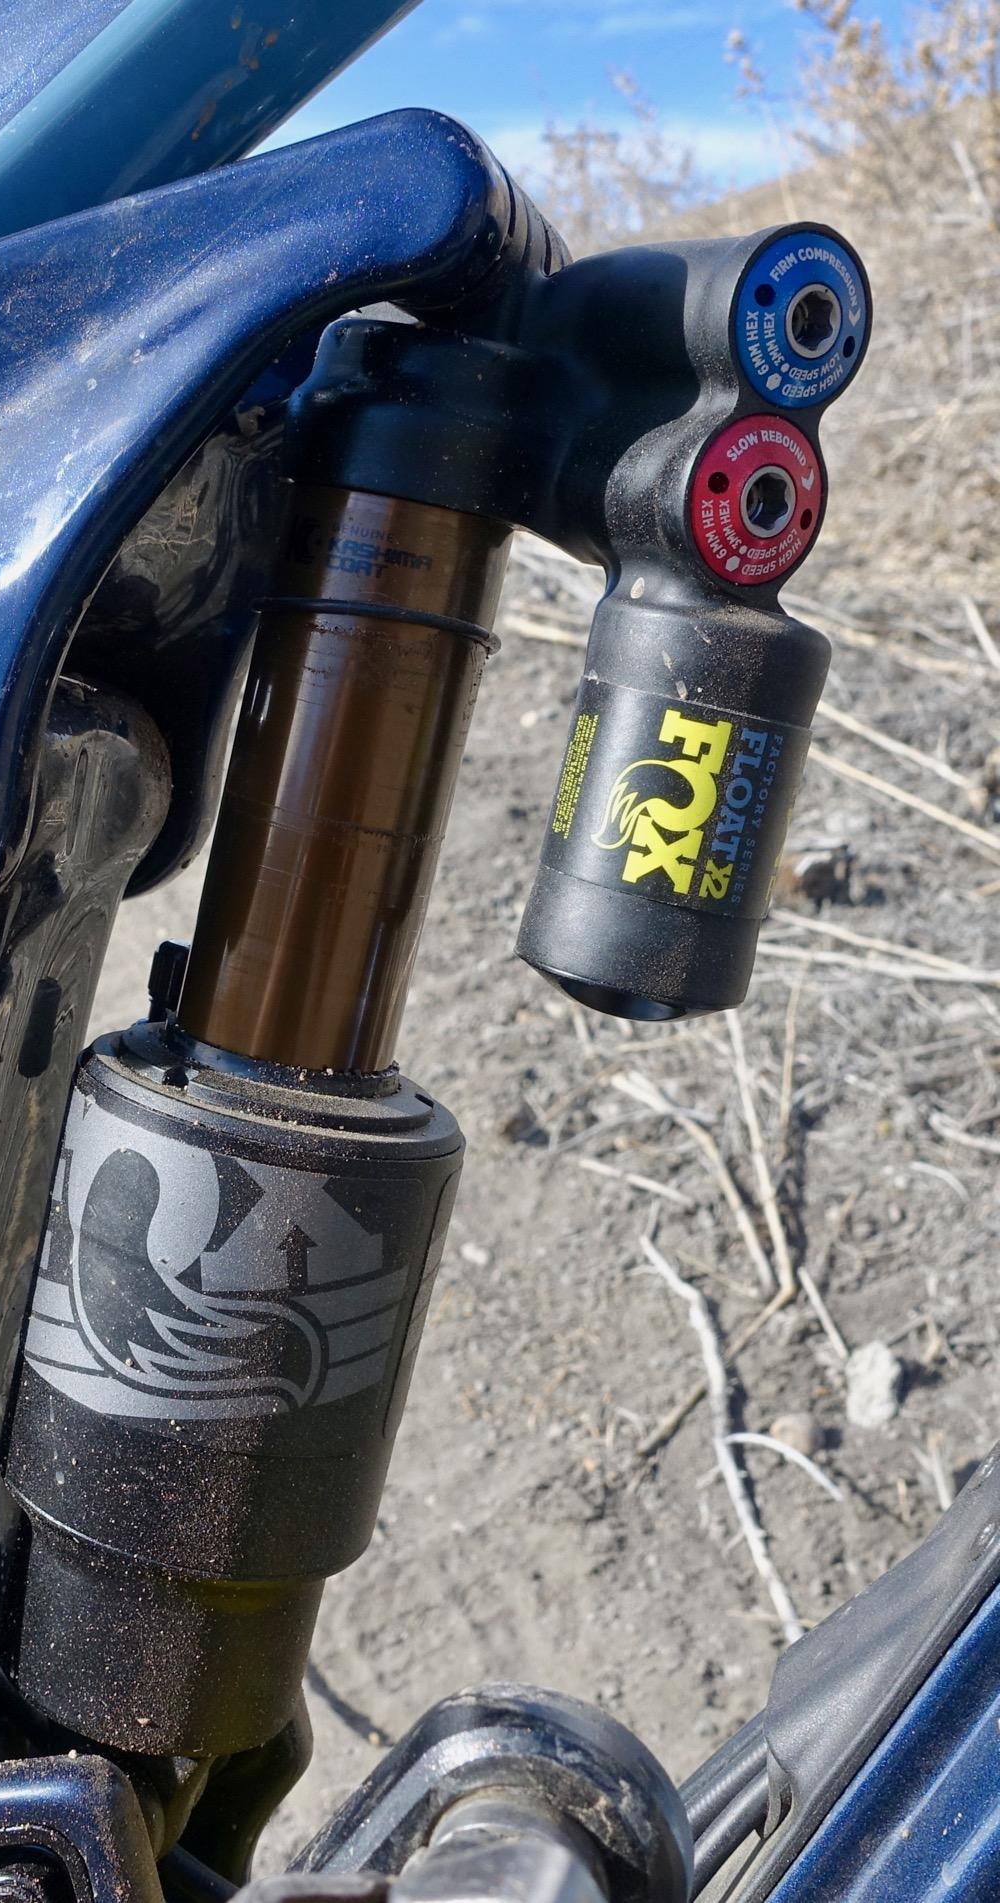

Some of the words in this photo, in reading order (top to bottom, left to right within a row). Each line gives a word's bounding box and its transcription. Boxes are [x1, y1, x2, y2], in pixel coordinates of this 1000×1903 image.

[769, 252, 798, 282] FIRM
[798, 247, 858, 307] COMPRESSION
[746, 310, 760, 342] HEX
[763, 312, 776, 338] HEX
[748, 342, 770, 376] 6MM
[765, 339, 785, 367] 3MM
[820, 352, 840, 377] LOW
[788, 367, 820, 381] SPEED
[819, 364, 844, 393] HIGH
[781, 383, 818, 398] SPEED
[726, 431, 759, 462] SLOW
[760, 429, 807, 466] REBOUND
[701, 499, 715, 530] HEX
[719, 499, 731, 526] HEX
[705, 529, 728, 559] 6MM
[722, 524, 742, 550] 3MM
[779, 527, 798, 553] LOW
[747, 546, 778, 560] SPEED
[778, 538, 803, 567] HIGH
[741, 560, 777, 576] SPEED
[710, 727, 768, 863] FLOAT
[751, 733, 785, 828] FACTORY
[591, 709, 733, 895] FOX
[698, 858, 735, 900] X2
[731, 837, 757, 904] SERIES
